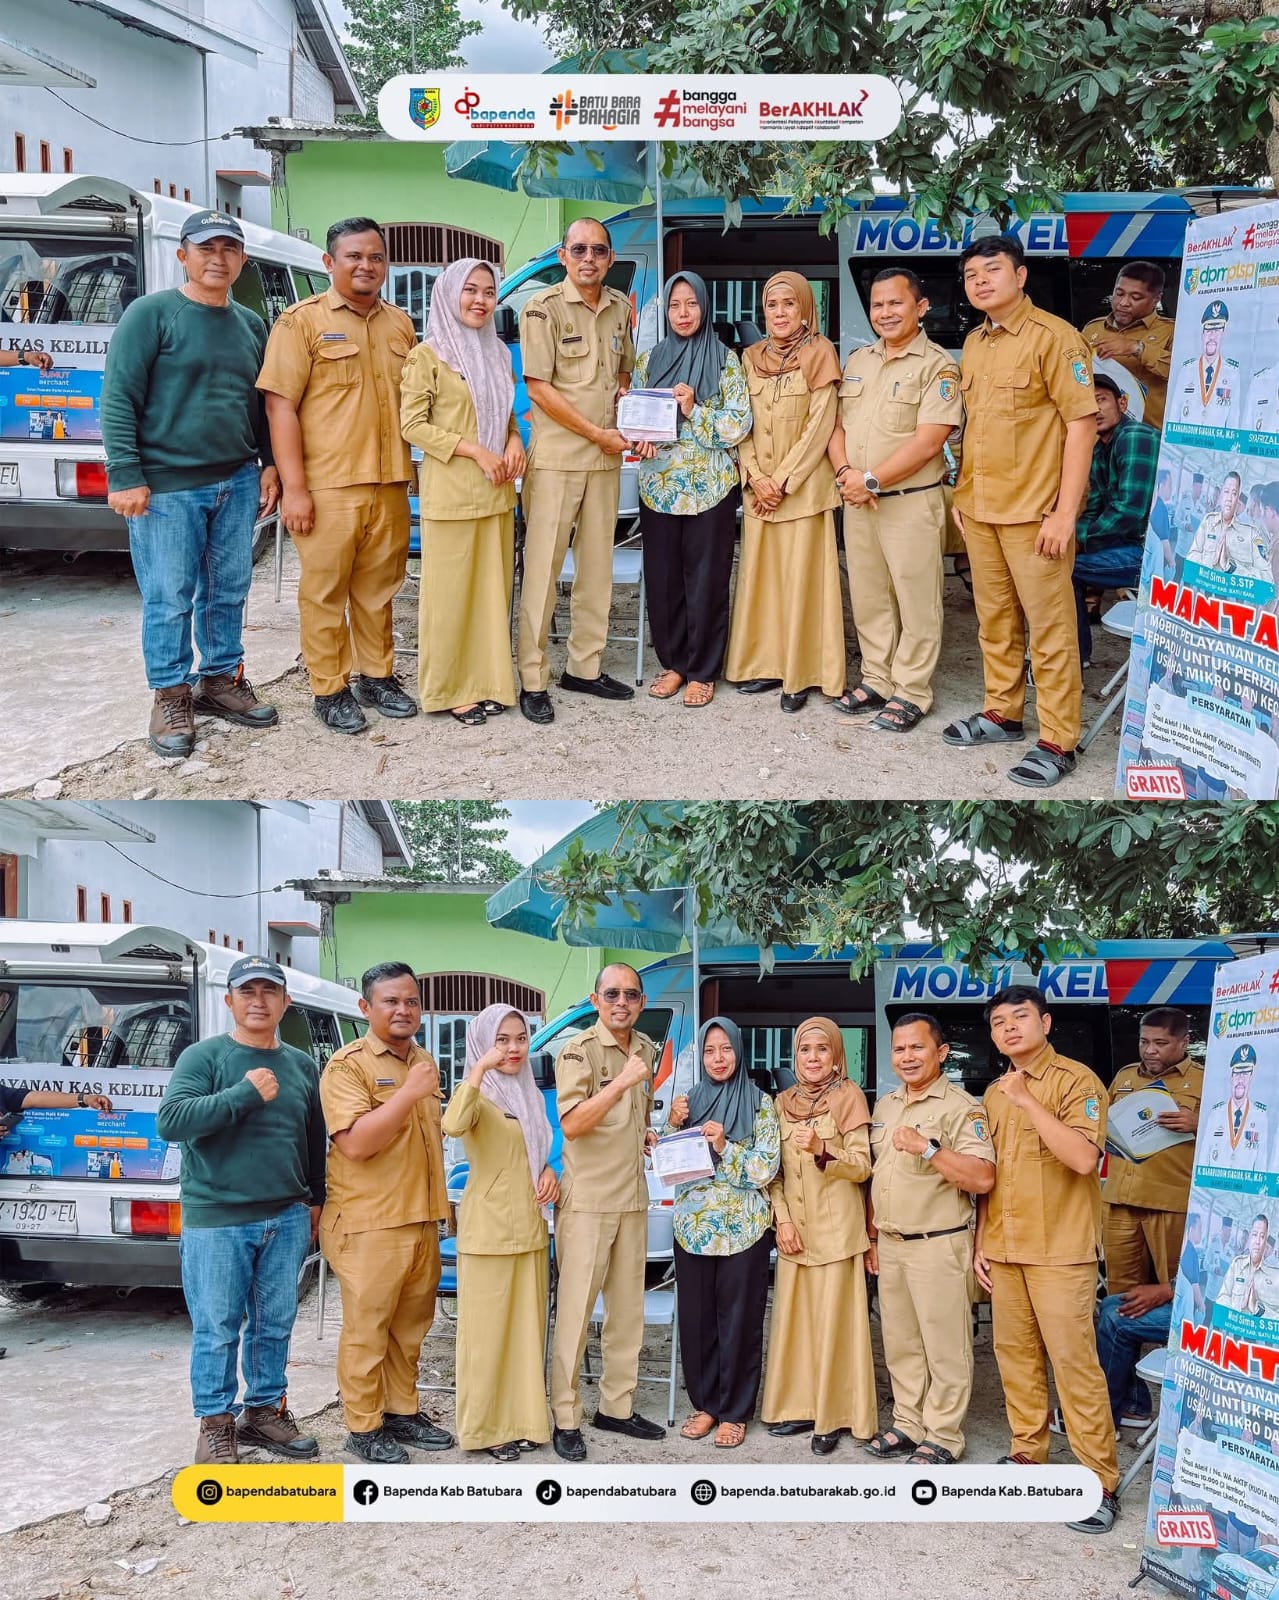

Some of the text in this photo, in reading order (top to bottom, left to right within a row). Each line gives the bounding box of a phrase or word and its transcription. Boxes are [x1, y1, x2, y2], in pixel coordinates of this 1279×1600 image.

[1187, 236, 1233, 253] BerAKHLAK
[9, 338, 44, 353] KAS
[1, 467, 18, 485] EU
[1230, 576, 1255, 589] S.STP
[1144, 629, 1181, 657] TERPADU
[1182, 647, 1231, 675] UNTUK
[1150, 617, 1179, 638] MOBIL
[1180, 628, 1254, 664] PELAYANAN
[1257, 654, 1279, 676] KEL
[1156, 651, 1279, 716] USAHA MIKRO DAN KEC
[1191, 696, 1251, 729] PERSYARATAN
[1129, 774, 1181, 794] GRATIS
[1216, 979, 1261, 997] BerAKHLAK
[68, 1081, 103, 1095] KAS
[108, 1082, 167, 1098] KELILI
[58, 1204, 76, 1222] EU
[1180, 1359, 1208, 1383] MOBIL
[1173, 1372, 1211, 1401] TERPADU
[1212, 1392, 1261, 1419] UNTUK
[1186, 1395, 1213, 1420] USAHA
[1215, 1410, 1261, 1436] MIKRO
[1159, 1520, 1212, 1540] GRATIS
